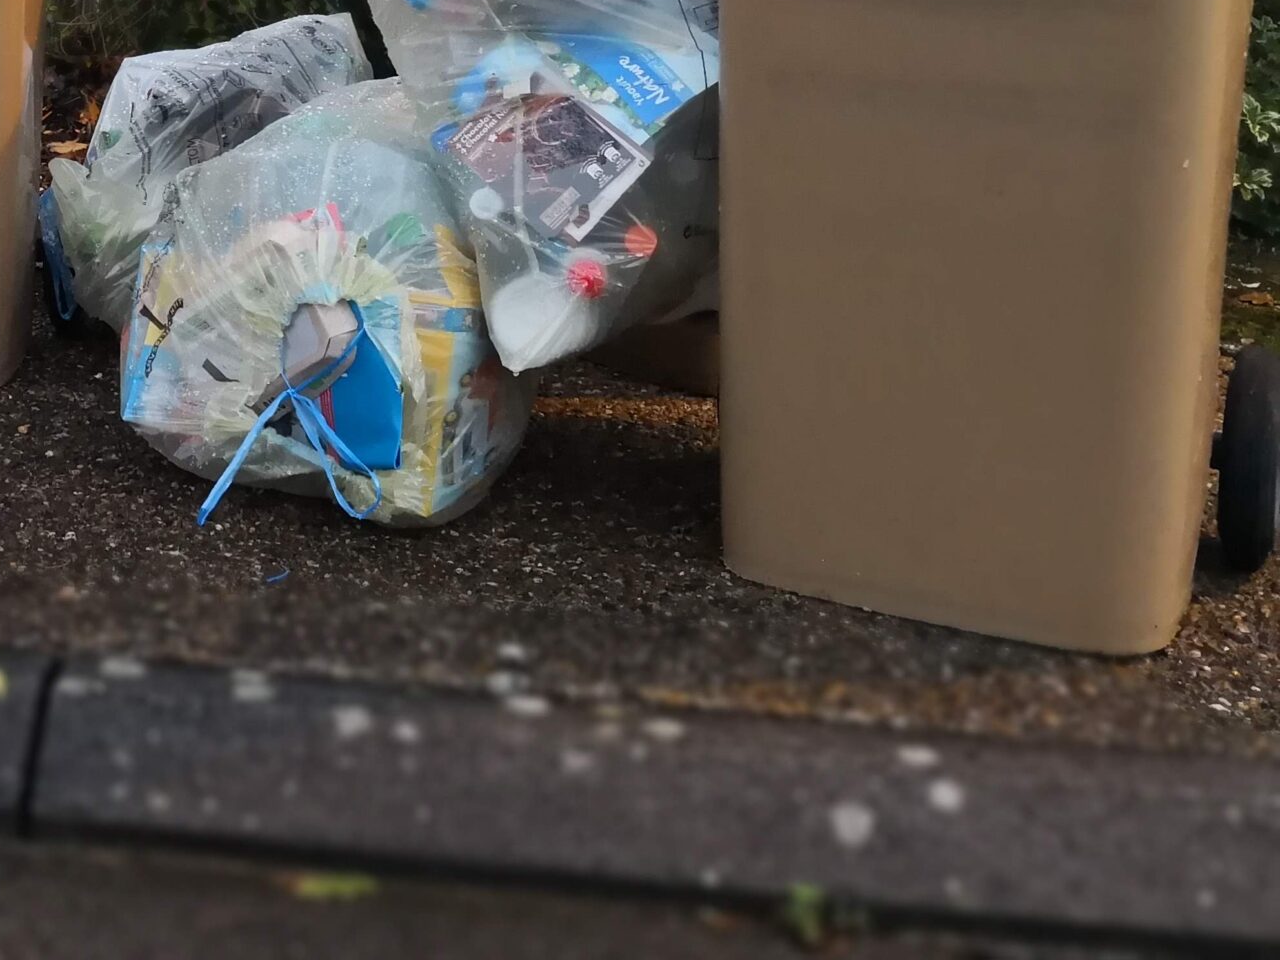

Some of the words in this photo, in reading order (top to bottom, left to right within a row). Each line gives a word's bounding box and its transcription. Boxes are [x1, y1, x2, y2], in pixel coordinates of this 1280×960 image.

[616, 75, 645, 106] Yaourt
[618, 55, 671, 105] Nature
[459, 112, 492, 144] Chocolat
[465, 117, 498, 148] Chocolat
